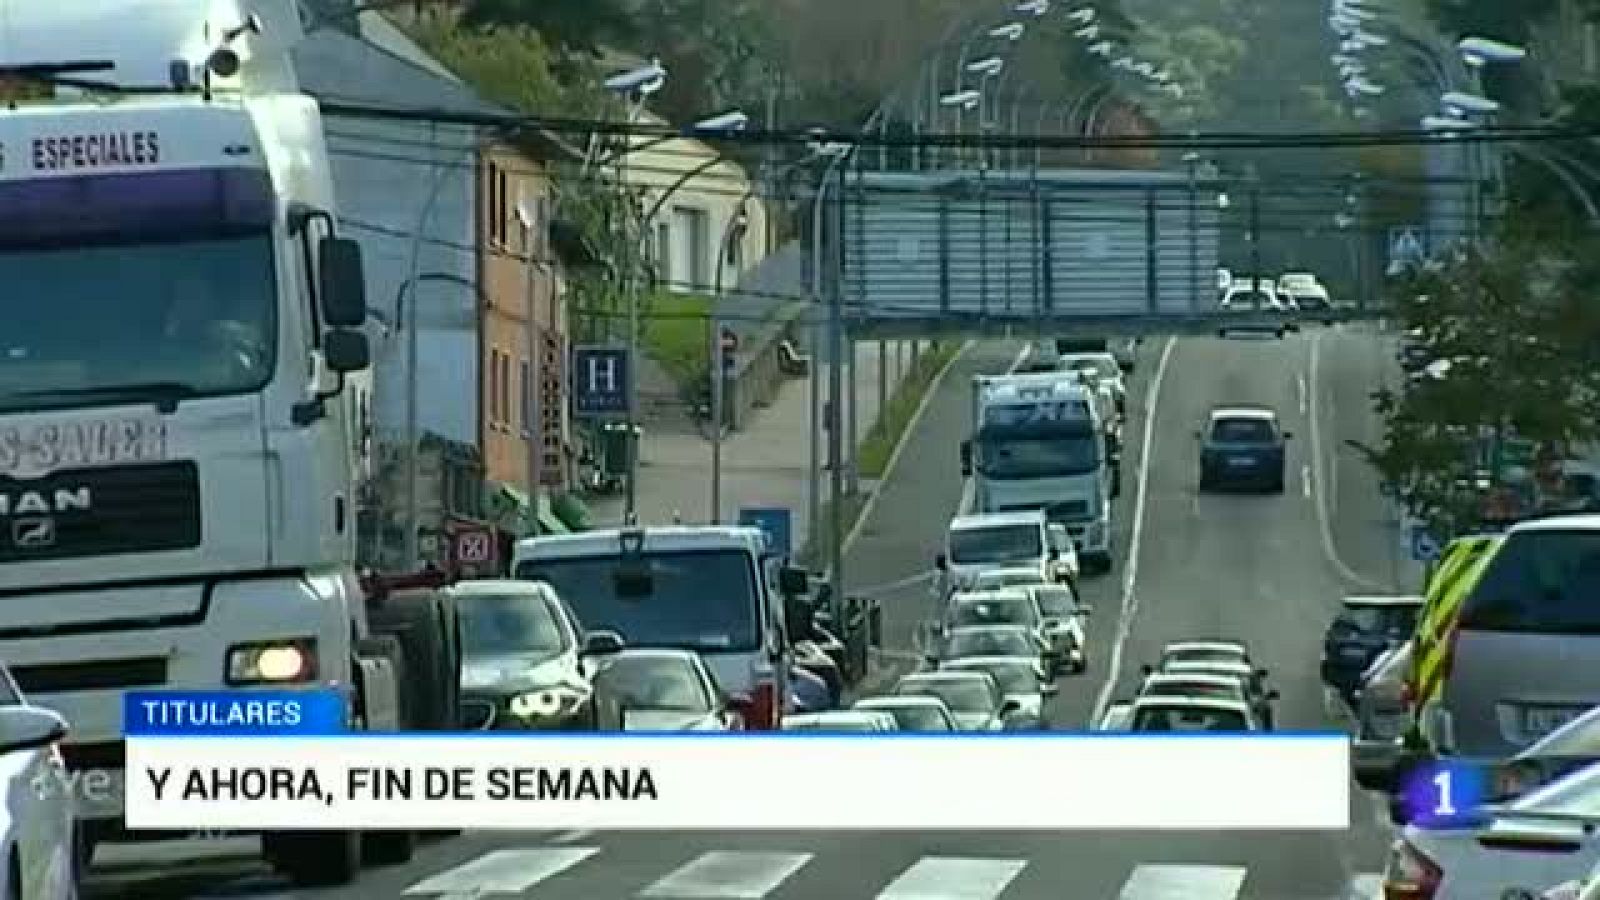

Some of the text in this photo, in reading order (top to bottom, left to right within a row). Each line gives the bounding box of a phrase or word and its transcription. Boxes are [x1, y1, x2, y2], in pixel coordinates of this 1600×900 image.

[32, 130, 160, 170] ESPECIALES
[588, 357, 616, 392] H
[0, 486, 92, 516] AN
